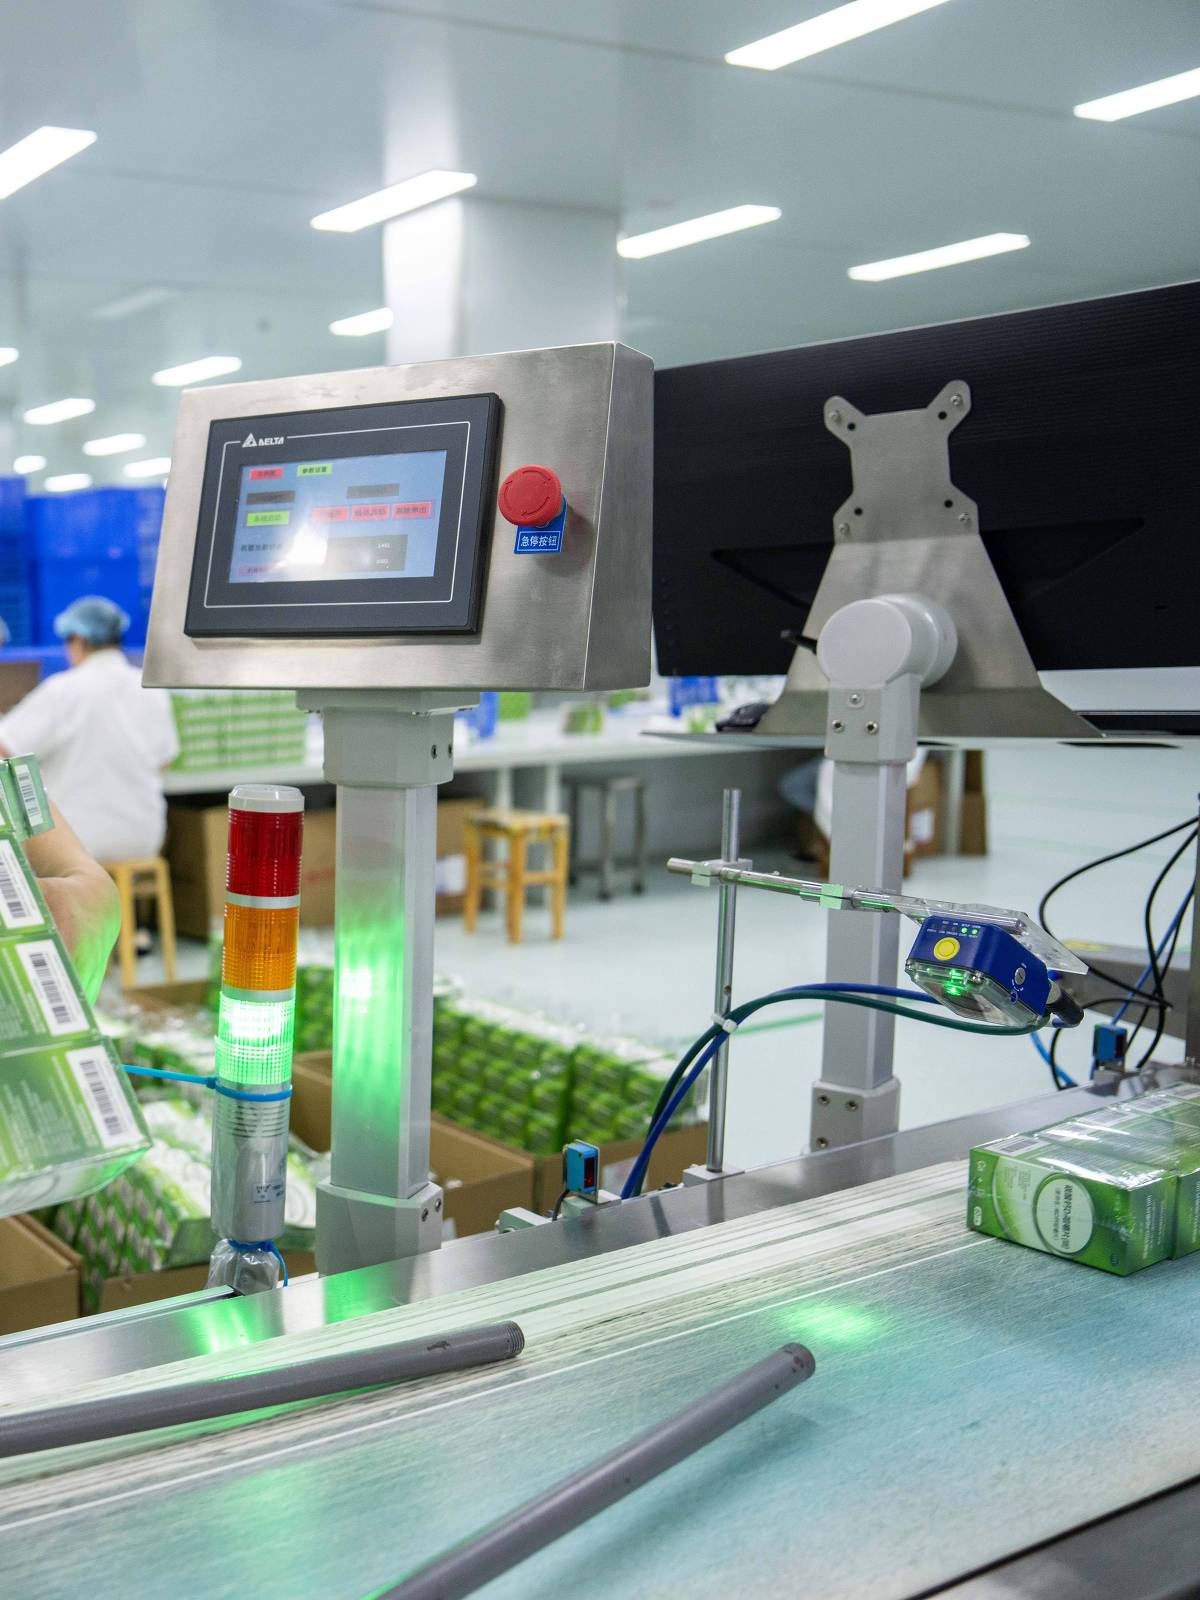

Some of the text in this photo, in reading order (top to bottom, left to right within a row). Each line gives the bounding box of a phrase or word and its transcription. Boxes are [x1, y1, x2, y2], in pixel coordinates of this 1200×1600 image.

[258, 436, 285, 447] DELTA
[520, 535, 558, 547] 急停按钮
